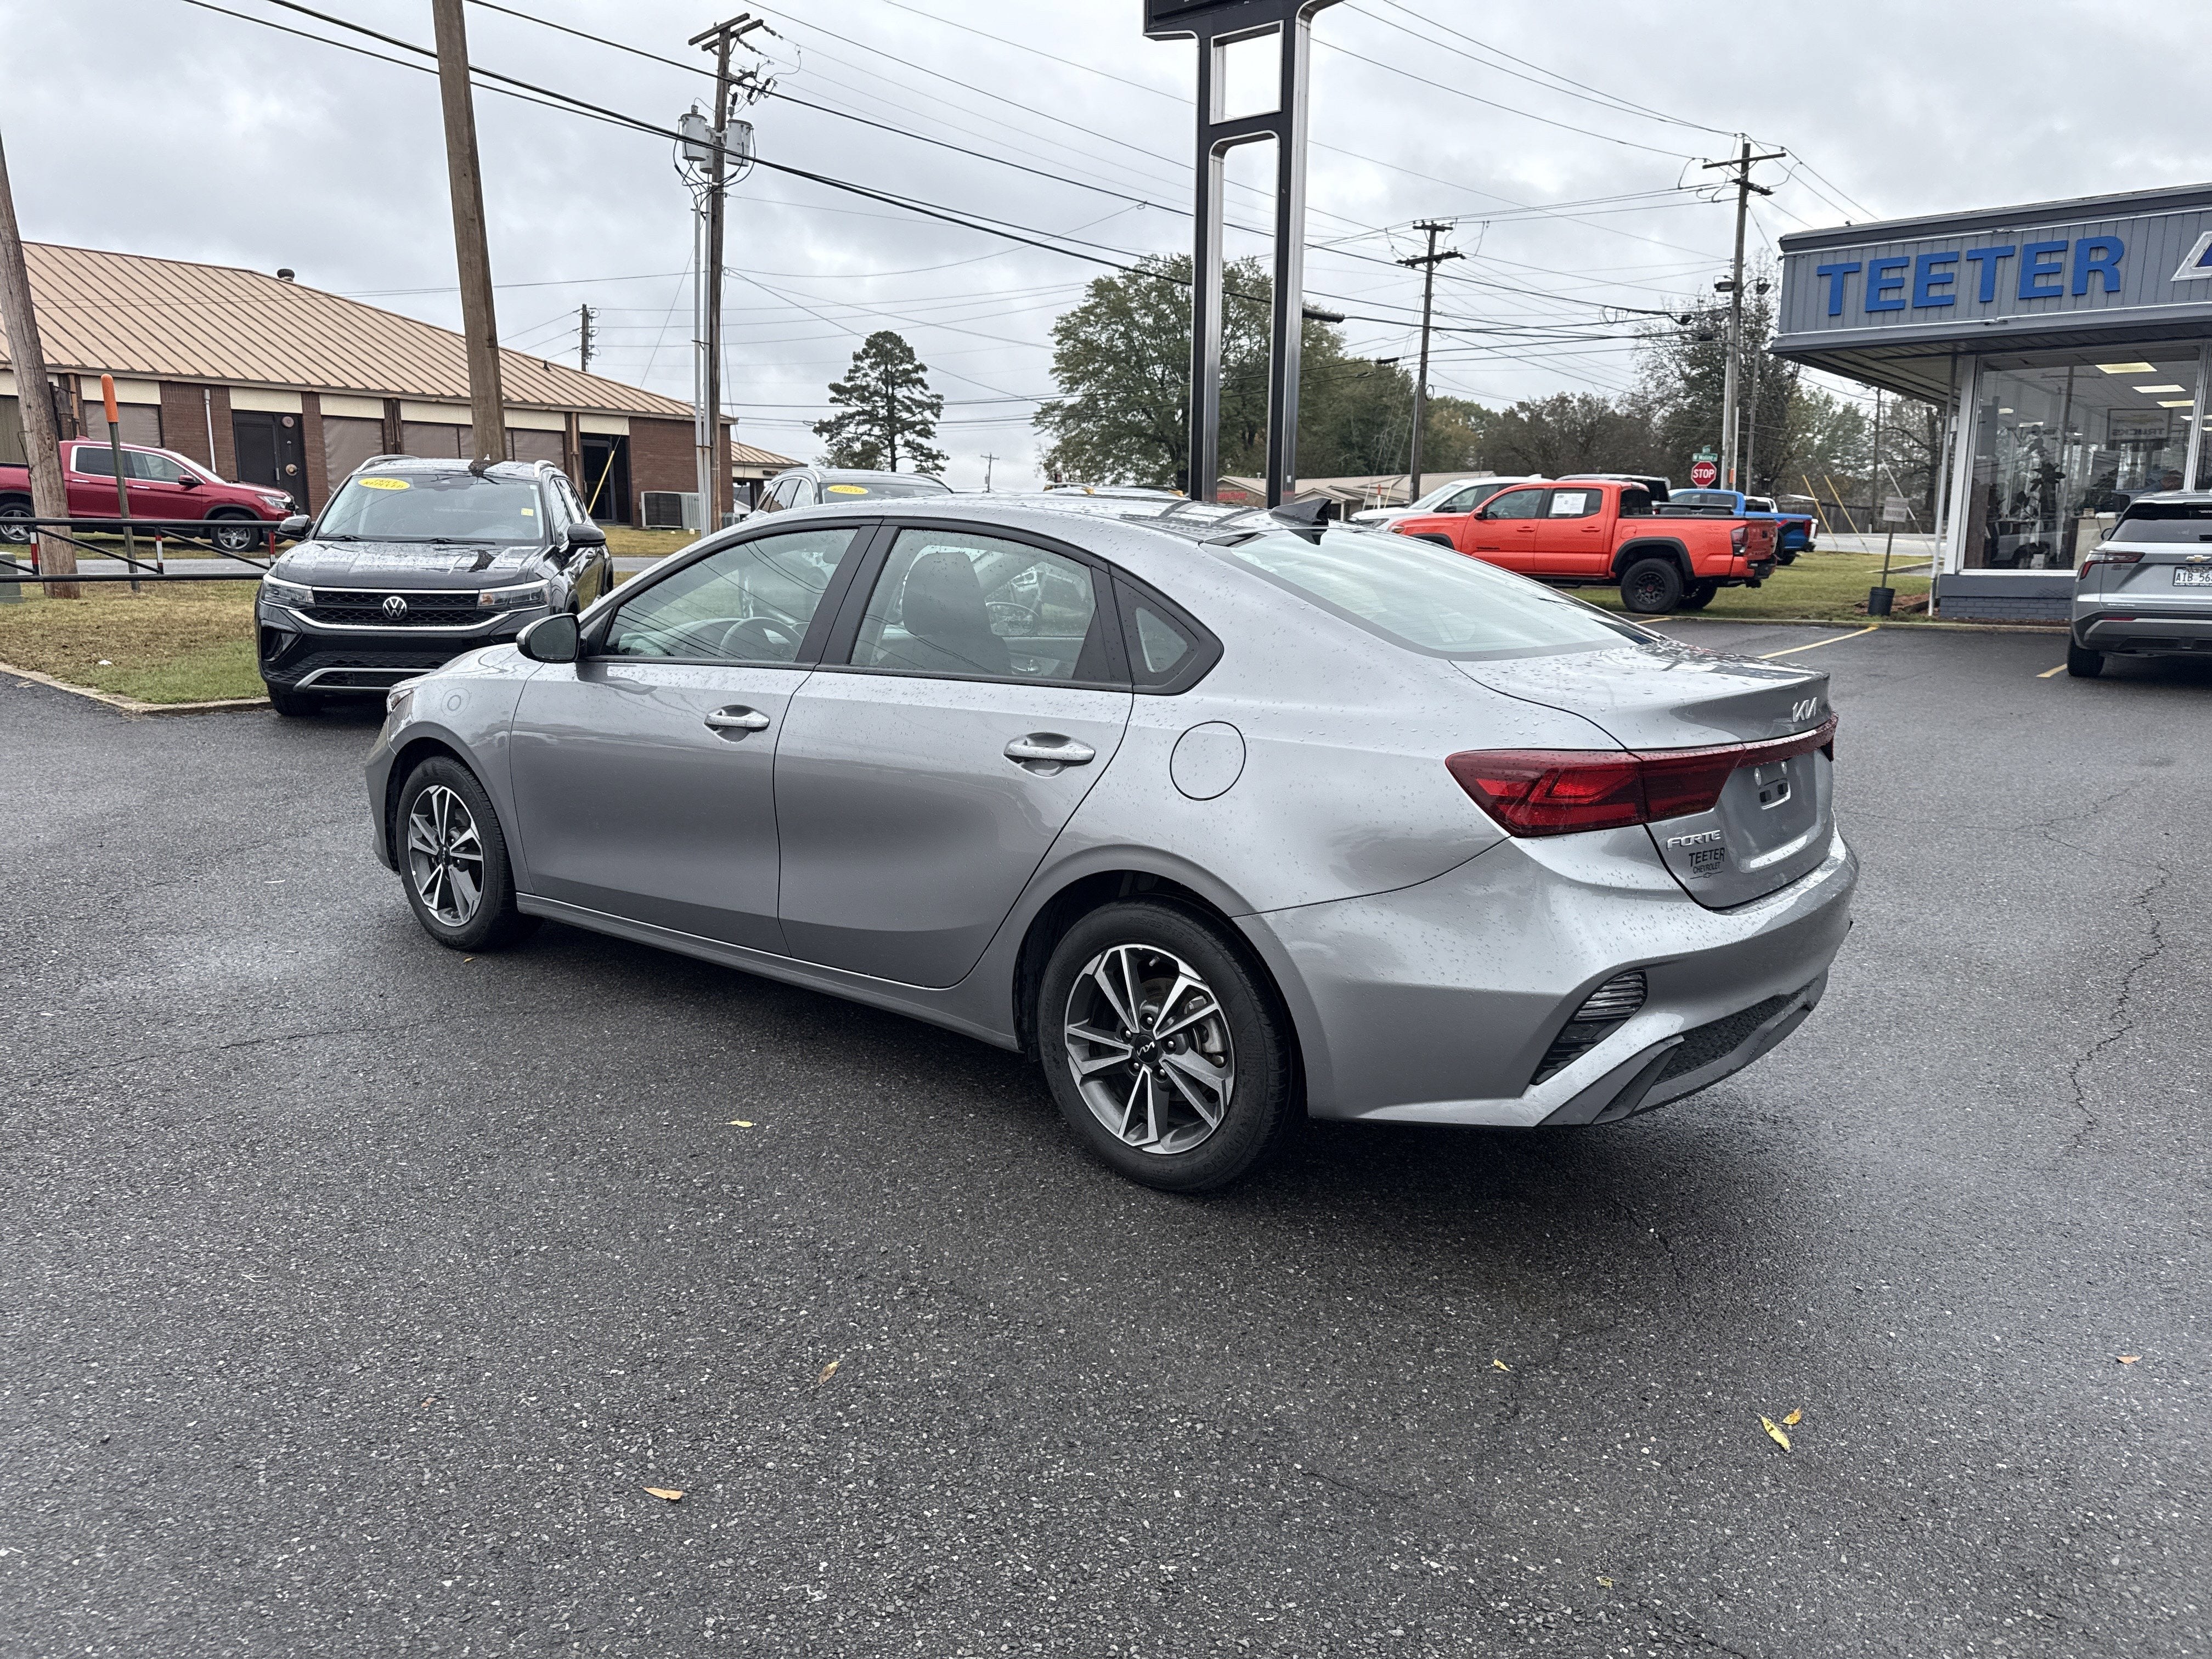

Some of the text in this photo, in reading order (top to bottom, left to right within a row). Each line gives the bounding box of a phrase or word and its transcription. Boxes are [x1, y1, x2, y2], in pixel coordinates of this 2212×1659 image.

[1817, 236, 2125, 315] TEETER
[1692, 469, 1714, 478] STOP
[2176, 573, 2212, 582] AIB 56
[1666, 830, 1721, 851] FORTE
[1688, 847, 1725, 867] TEETER
[1692, 861, 1721, 874] CHEVROLET
